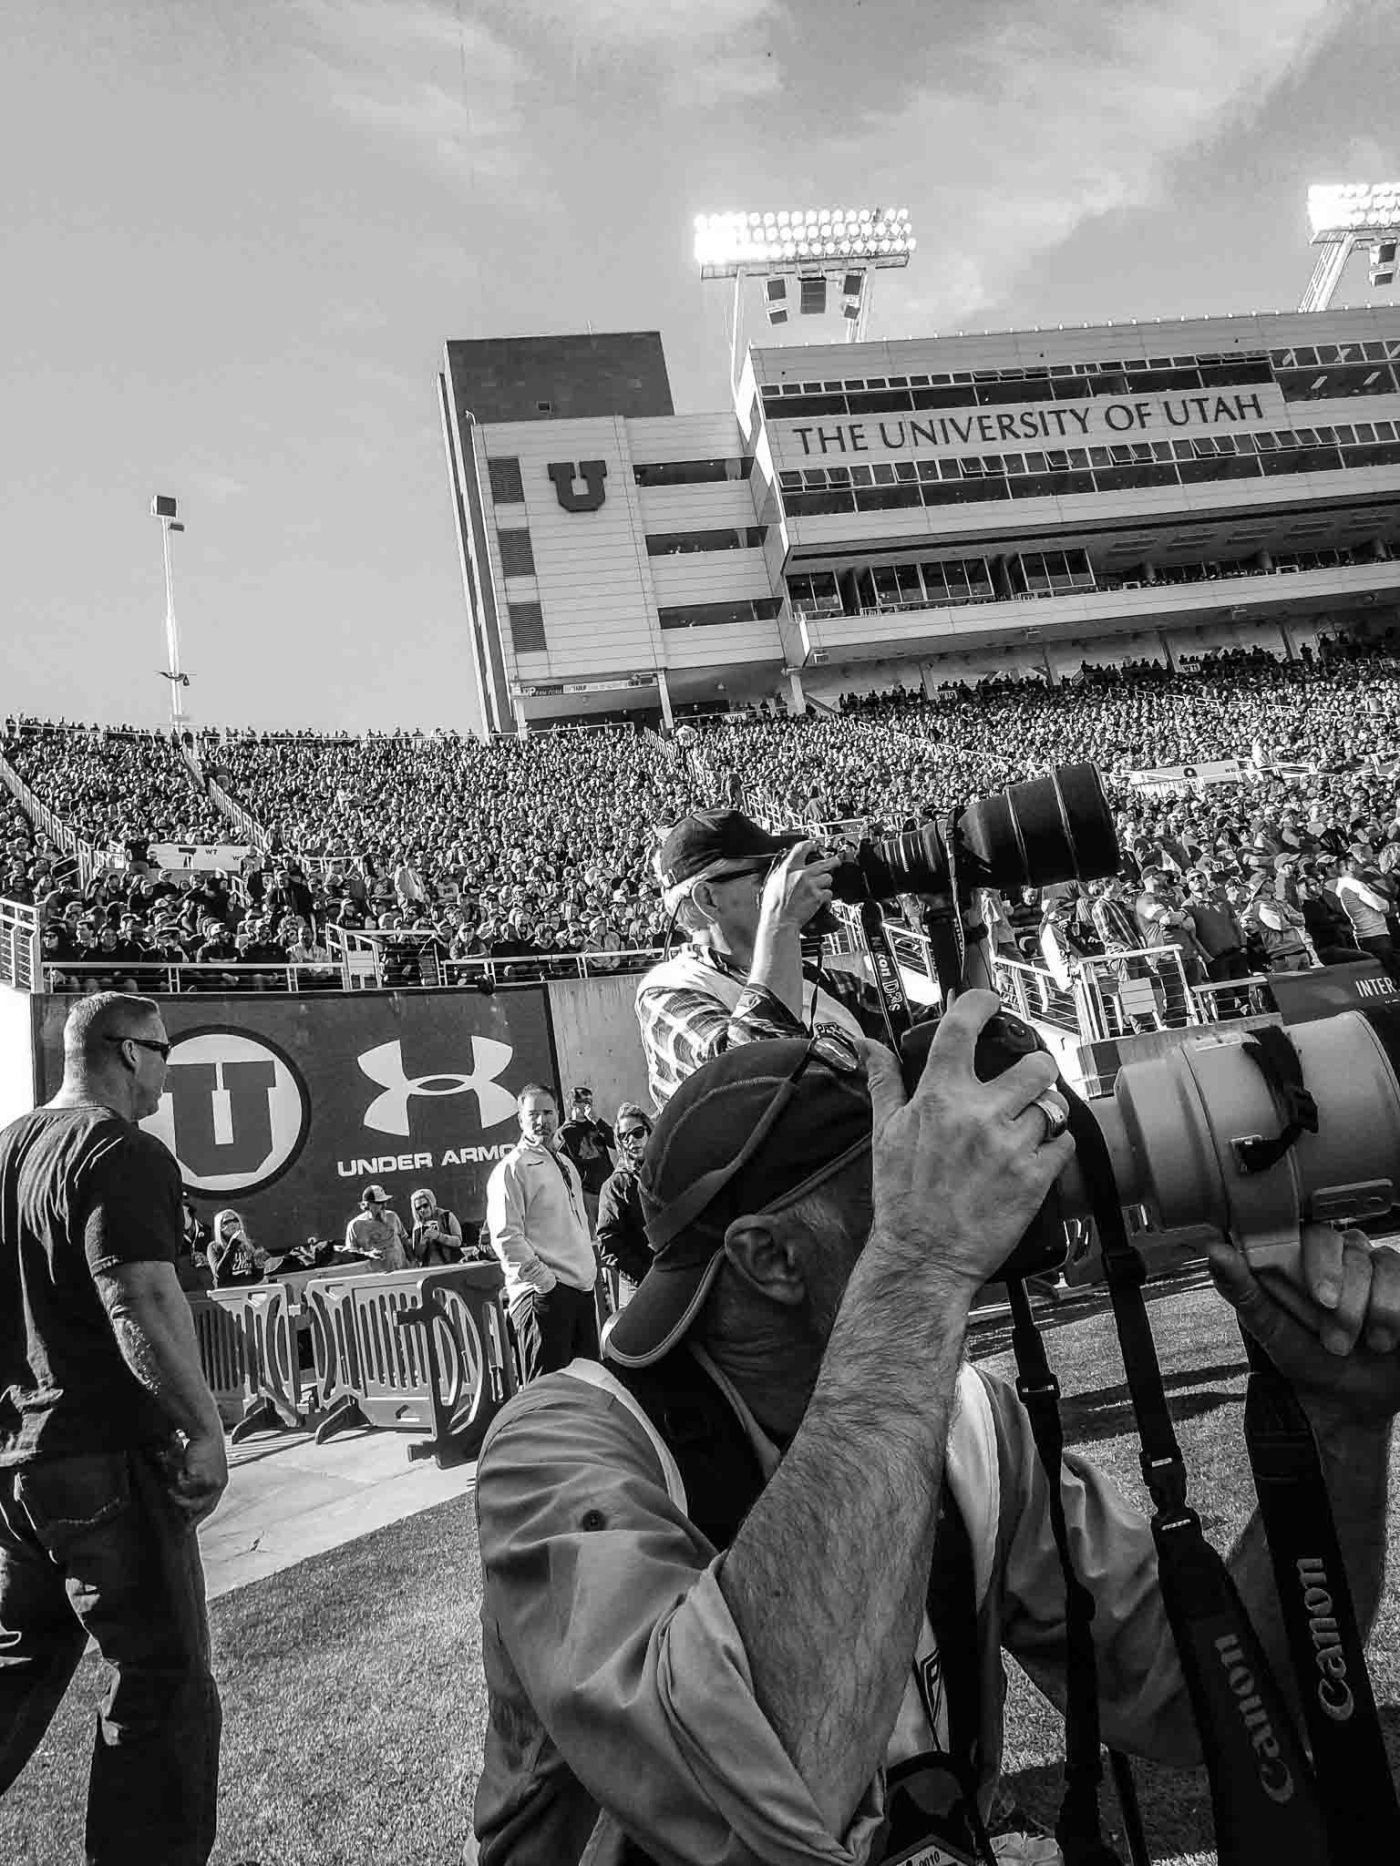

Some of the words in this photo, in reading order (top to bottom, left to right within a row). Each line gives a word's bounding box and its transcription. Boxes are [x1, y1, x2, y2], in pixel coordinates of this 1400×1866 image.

[793, 423, 868, 455] THE
[880, 407, 1091, 449] UNIVERSITY
[1104, 402, 1152, 432] OF
[1162, 393, 1264, 426] UTAH
[547, 460, 607, 512] U
[162, 1060, 277, 1178] U
[337, 1152, 433, 1177] UNDER
[1296, 1558, 1354, 1721] Canon
[1214, 1633, 1294, 1803] Canon
